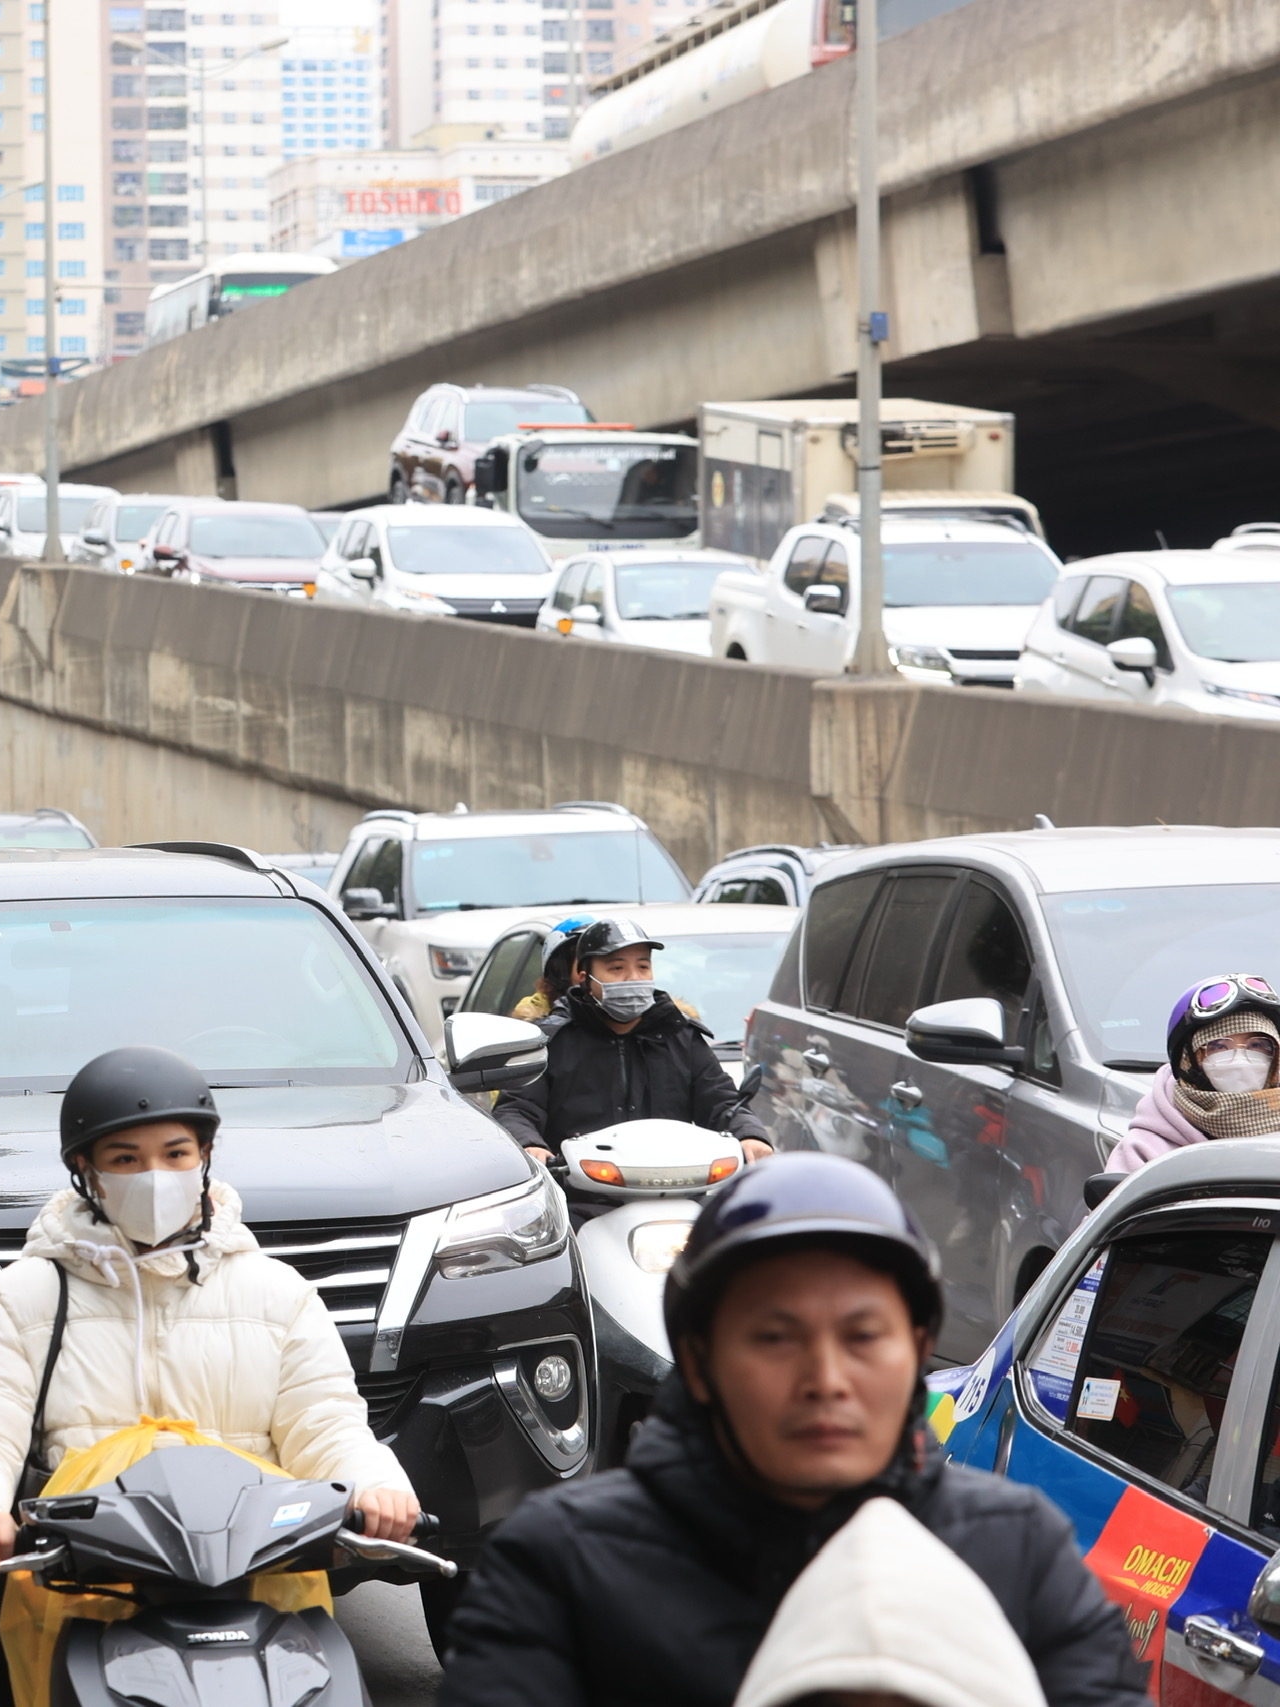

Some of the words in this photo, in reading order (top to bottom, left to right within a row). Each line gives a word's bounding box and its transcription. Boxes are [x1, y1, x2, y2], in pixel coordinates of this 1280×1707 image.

[639, 1177, 695, 1187] HONDA
[959, 1375, 986, 1413] 715
[1122, 1544, 1192, 1586] OMACHI
[1140, 1579, 1176, 1599] HOUSE
[187, 1630, 251, 1645] HONDA
